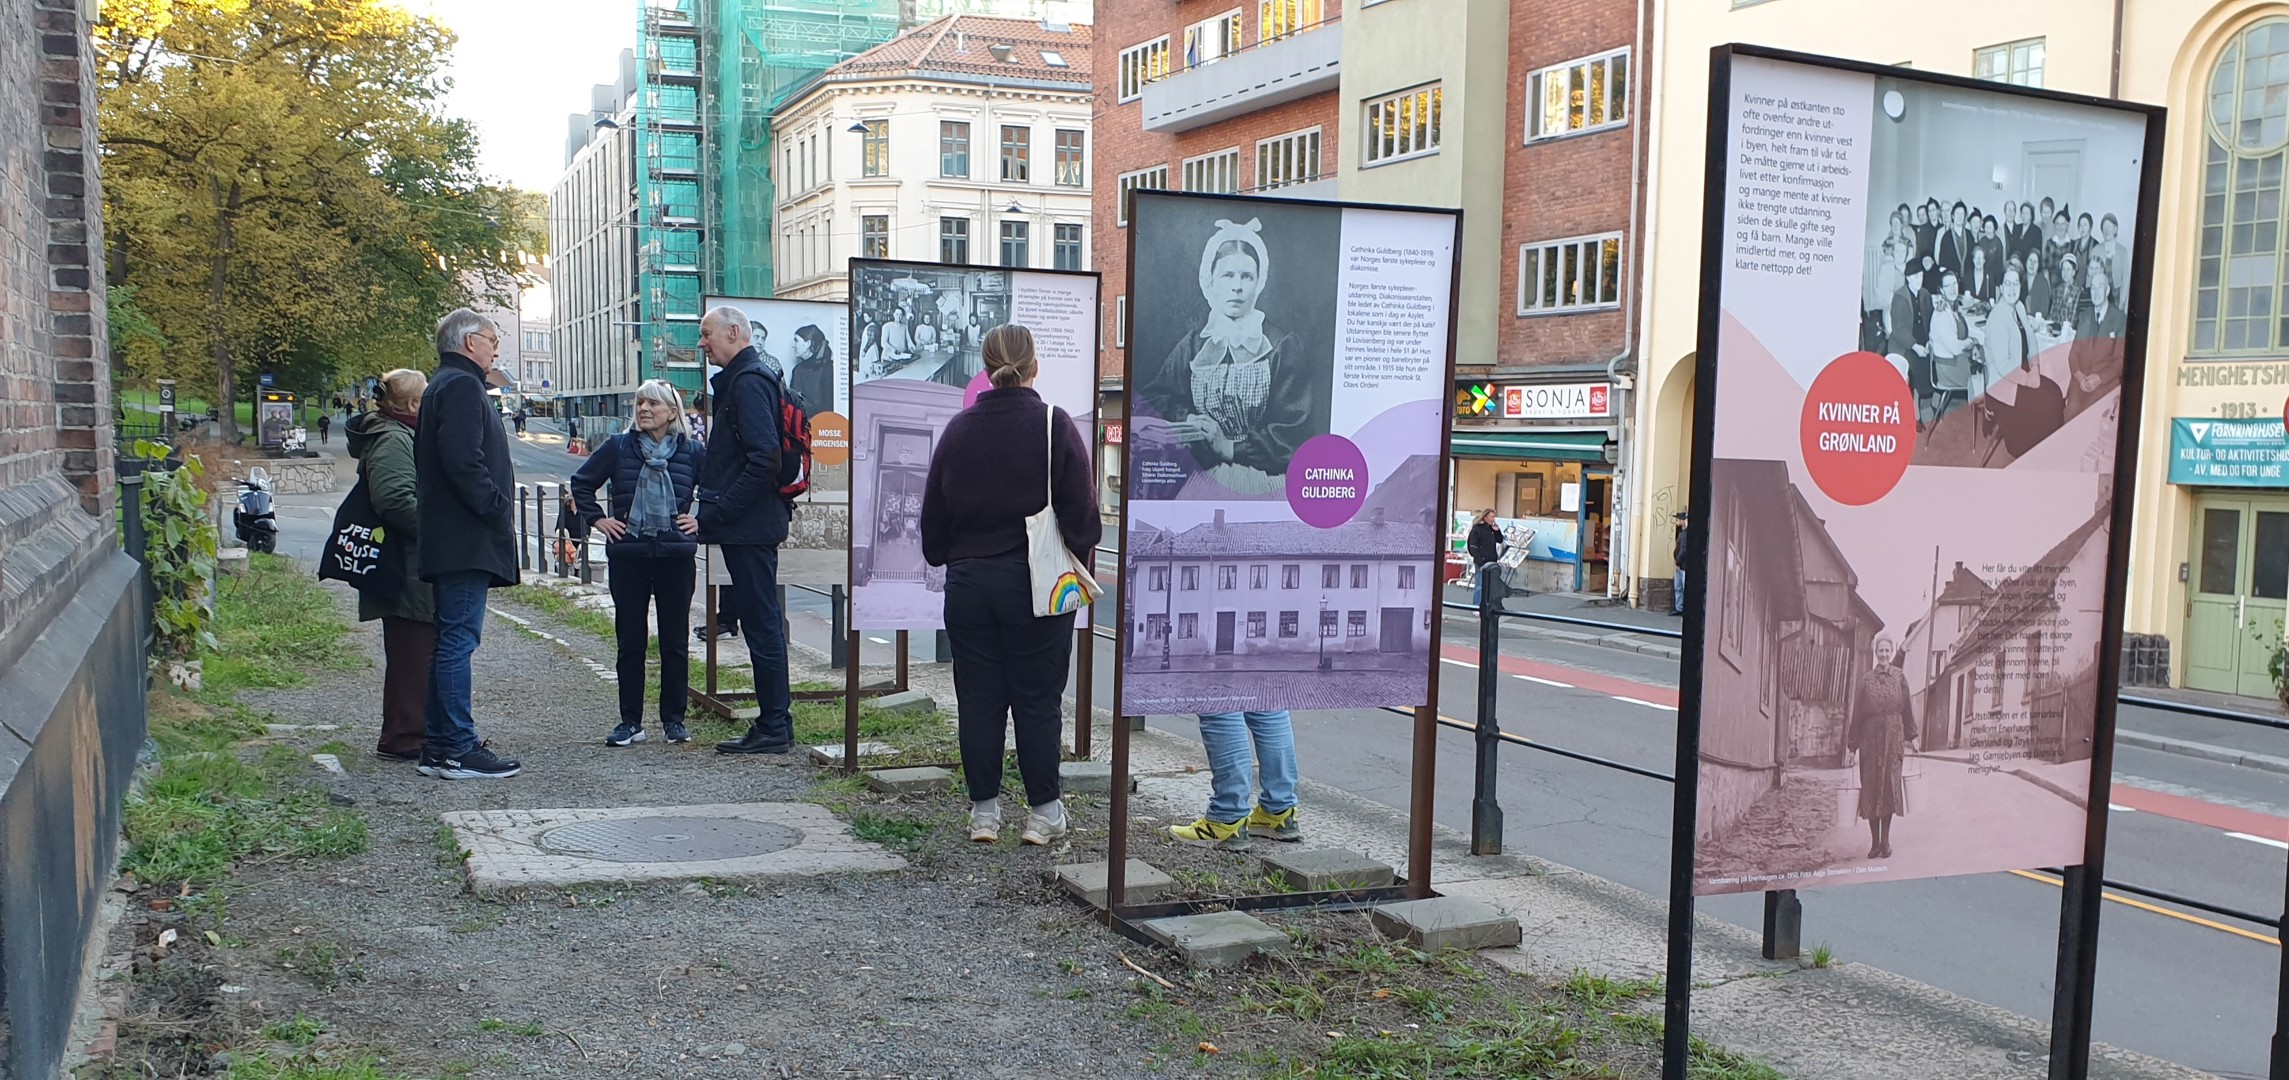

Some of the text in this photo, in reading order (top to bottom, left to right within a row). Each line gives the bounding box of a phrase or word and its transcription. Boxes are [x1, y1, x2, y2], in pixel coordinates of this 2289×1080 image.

[1745, 94, 1845, 115] Kvinner på østkanten sto
[1743, 109, 1834, 128] ofte ovenfor andre ut-
[1742, 124, 1784, 140] fordringer
[1805, 131, 1834, 144] kvinner
[1837, 138, 1853, 146] vest
[1741, 138, 1743, 148] i
[1746, 139, 1768, 153] byen,
[1772, 142, 1787, 153] helt
[1790, 144, 1808, 155] fram
[1821, 148, 1833, 158] vår
[1836, 150, 1847, 160] tid.
[1740, 154, 1752, 164] De
[1754, 156, 1778, 167] måtte
[1807, 163, 1815, 171] ut
[1817, 162, 1819, 172] i
[1822, 164, 1852, 175] arbeids-
[1740, 169, 1834, 190] livet etter konfirmasjon
[1739, 186, 1750, 197] og
[1753, 188, 1781, 199] mange
[1784, 191, 1809, 200] mente
[1822, 192, 1851, 204] kvinner
[1738, 199, 1754, 209] ikke
[1758, 202, 1787, 215] trengte
[1737, 215, 1835, 236] siden de skulle gifte seg
[1737, 230, 1832, 248] og få barn. Mange ville
[1361, 255, 1380, 264] Norges
[1376, 247, 1402, 257] Guldberg
[1736, 244, 1776, 257] imidlertid
[1799, 253, 1810, 263] og
[1735, 259, 1812, 276] klarte nettopp det!
[1349, 282, 1369, 291] Norges
[1388, 311, 1399, 320] dag
[1406, 302, 1431, 312] Guldberg
[1414, 320, 1420, 329] på
[1423, 356, 1429, 365] på
[1526, 389, 1585, 408] SONJA
[1819, 401, 1900, 424] KVINNER PÅ
[2221, 402, 2257, 418] 1913
[1820, 432, 1896, 453] GRØNLAND
[2180, 448, 2214, 460] KULTUR-
[2215, 449, 2225, 460] OG
[1305, 468, 1354, 480] CATHINKA
[2210, 465, 2227, 476] MED
[2241, 465, 2257, 477] FOR
[2260, 465, 2281, 477] UNGE
[1302, 486, 1355, 498] GULDBERG
[337, 534, 380, 559] HOUSE
[2057, 593, 2066, 601] og
